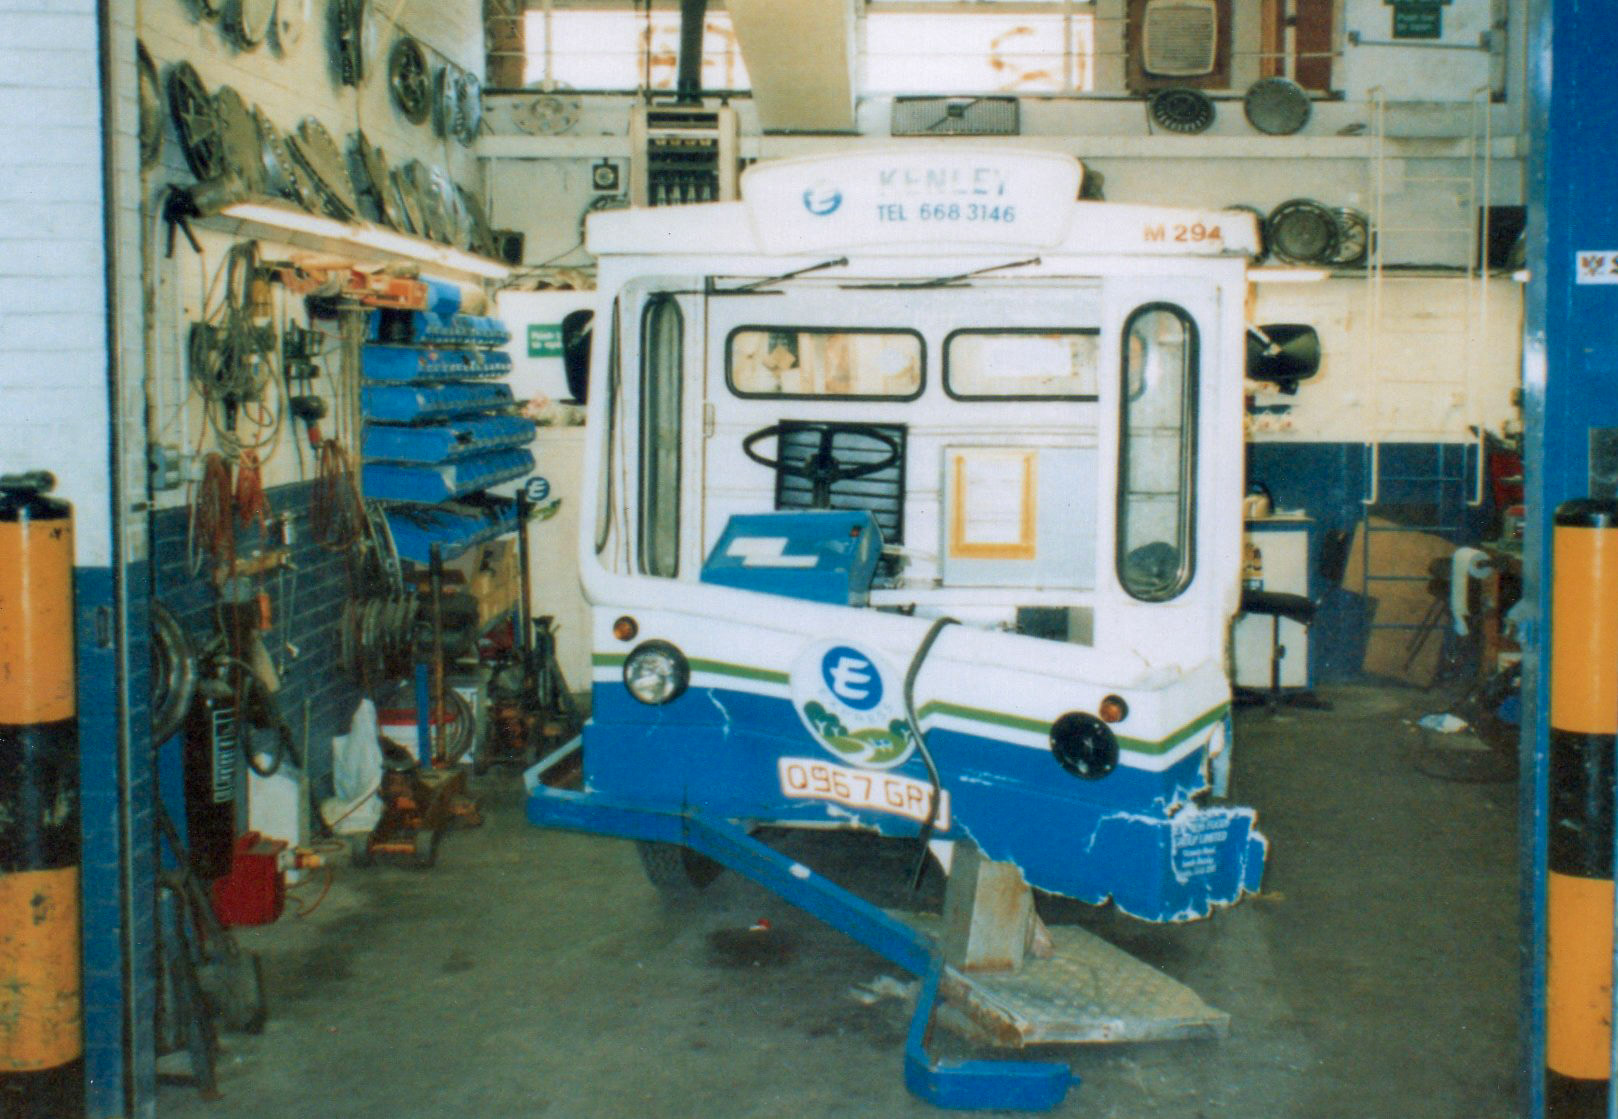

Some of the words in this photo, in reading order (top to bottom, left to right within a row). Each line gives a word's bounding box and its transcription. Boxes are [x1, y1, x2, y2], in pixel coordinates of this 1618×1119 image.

[877, 204, 907, 222] TEL
[919, 203, 960, 221] 668
[966, 204, 1016, 223] 3146
[1143, 224, 1165, 241] M
[1173, 224, 1221, 241] 294
